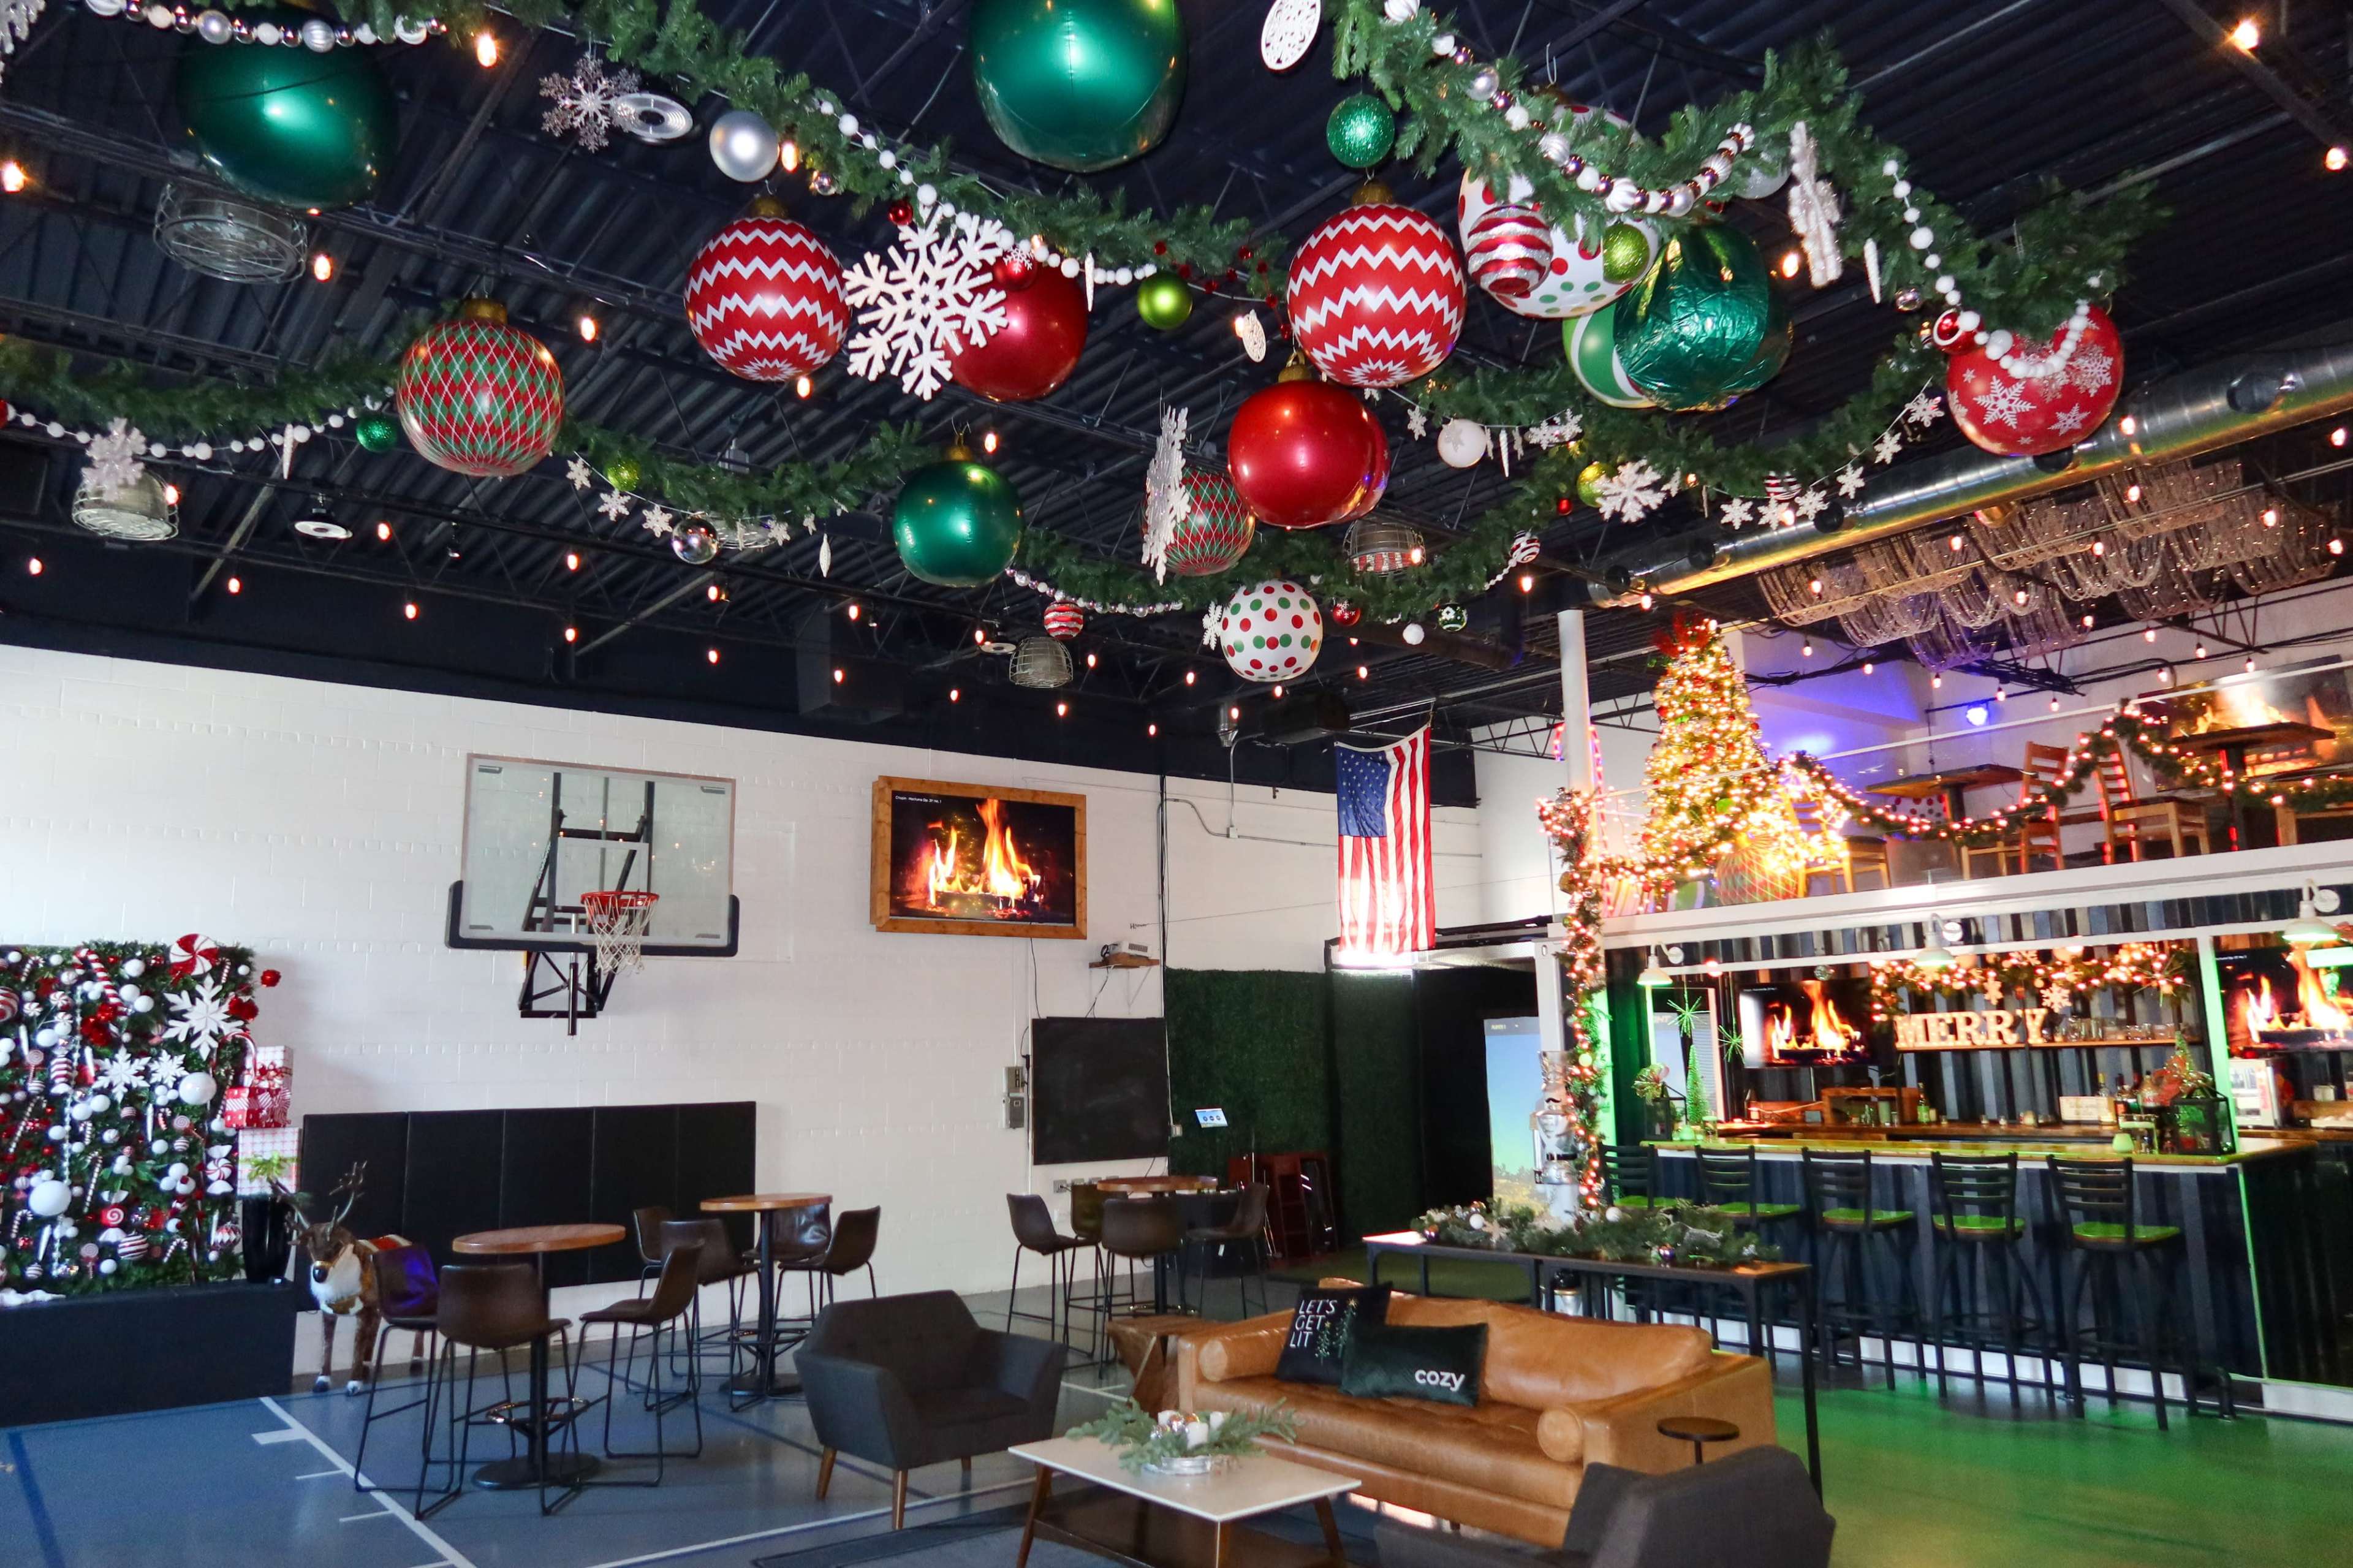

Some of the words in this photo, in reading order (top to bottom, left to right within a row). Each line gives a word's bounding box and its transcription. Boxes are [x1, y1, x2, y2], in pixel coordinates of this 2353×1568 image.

[1893, 1008, 2048, 1048] MERRY
[1298, 1299, 1338, 1314] LET'S
[1295, 1314, 1326, 1331] GET
[1289, 1330, 1313, 1348] LIT
[1414, 1369, 1466, 1392] cozy
